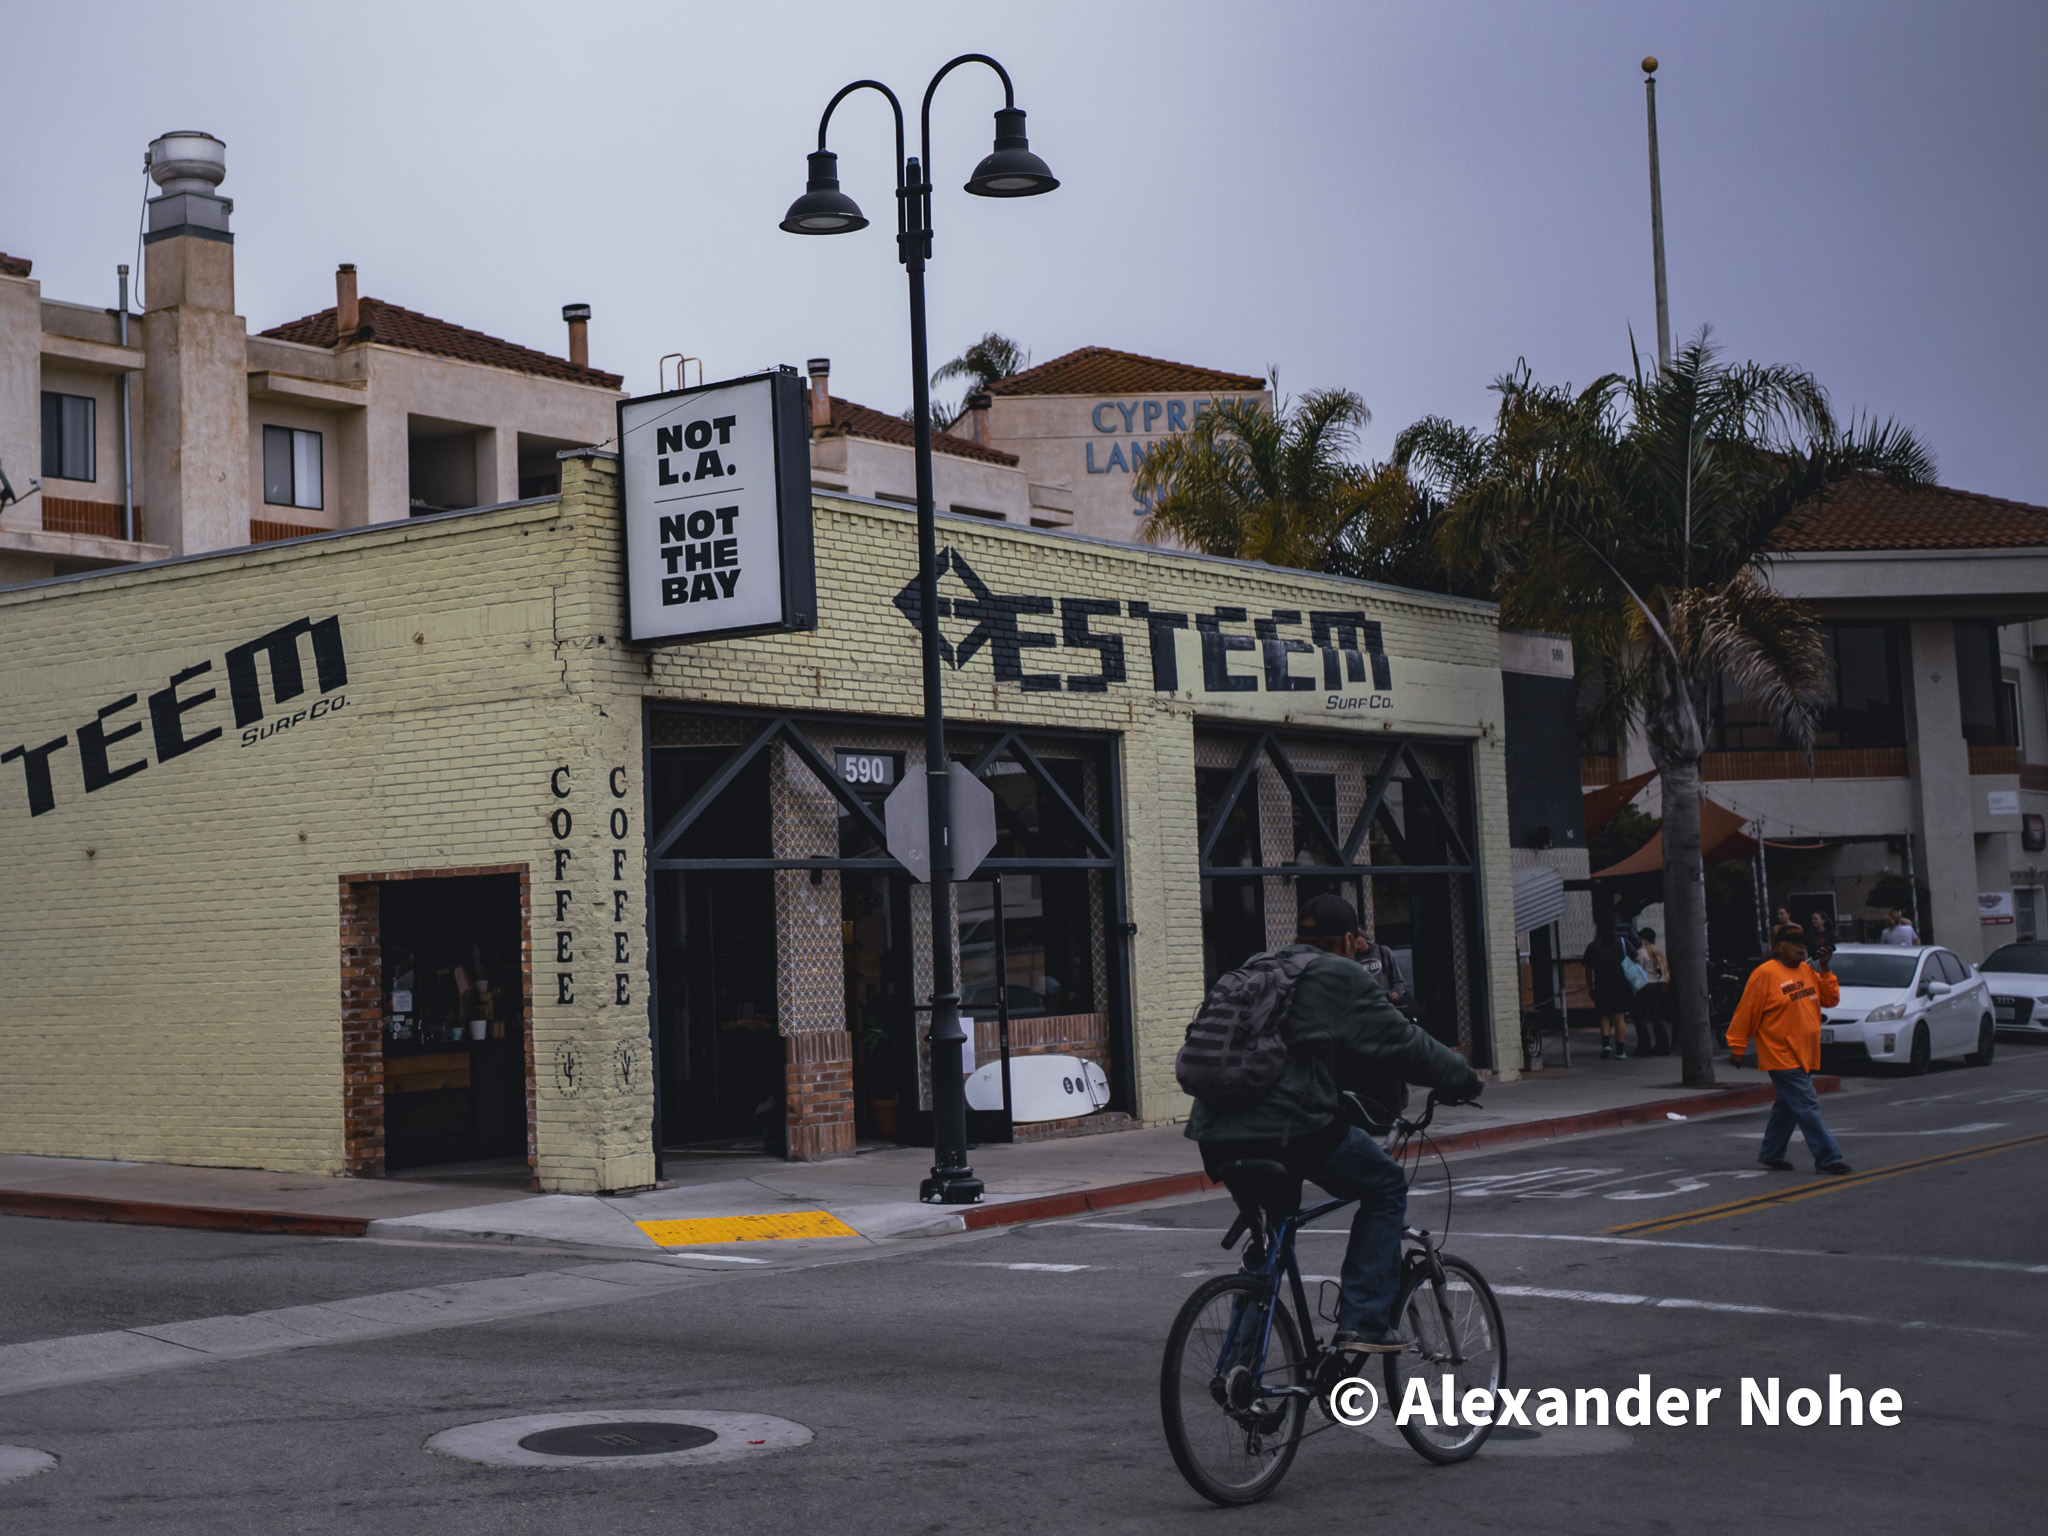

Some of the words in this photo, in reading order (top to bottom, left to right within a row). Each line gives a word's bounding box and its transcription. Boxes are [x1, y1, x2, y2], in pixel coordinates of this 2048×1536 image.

[657, 415, 737, 455] NOT
[1092, 398, 1258, 433] CYPRE
[658, 450, 737, 486] L.A.
[659, 505, 739, 544] NOT
[660, 537, 739, 574] THE
[662, 568, 742, 606] BAY
[984, 594, 1392, 692] ESTEEM
[0, 614, 348, 817] TEEM
[845, 756, 884, 784] 590
[551, 765, 575, 1005] COFFEE
[609, 765, 631, 1006] COFFEE
